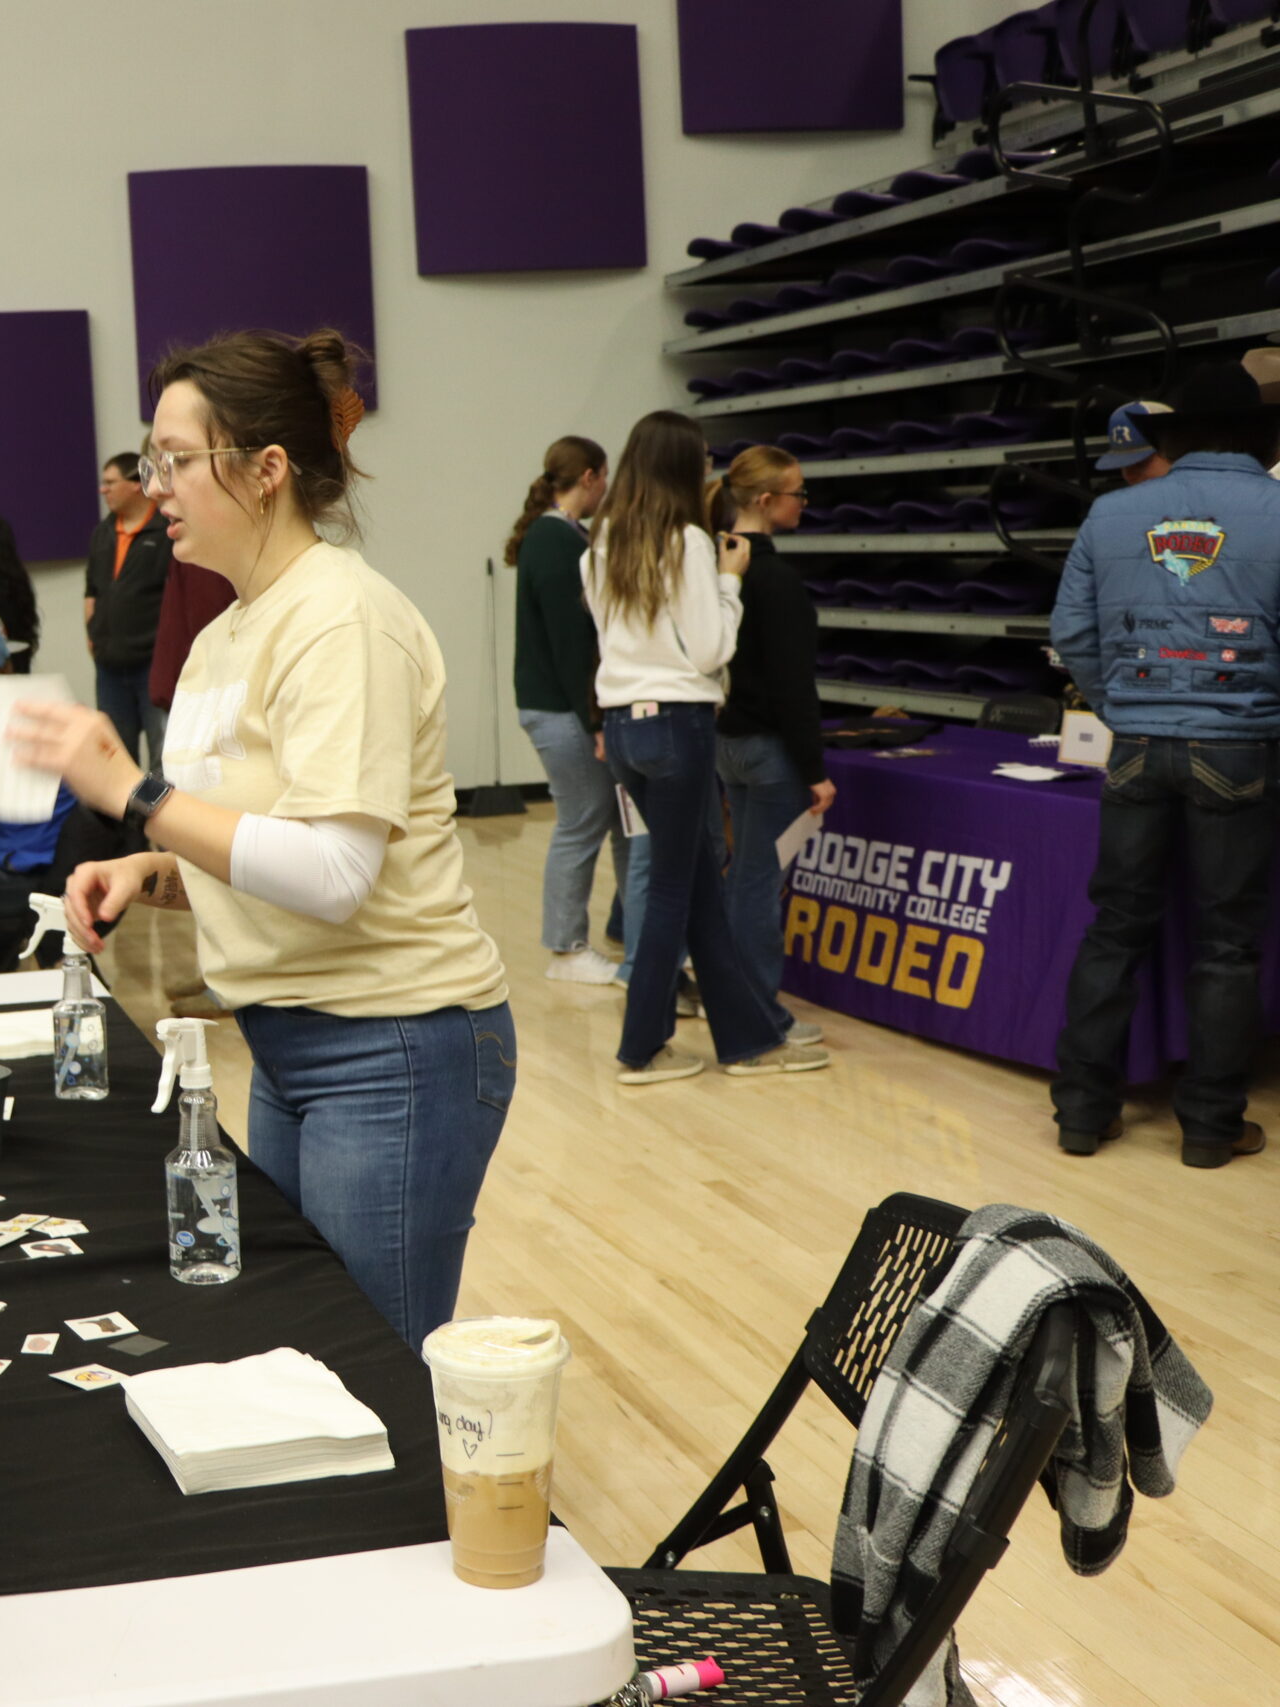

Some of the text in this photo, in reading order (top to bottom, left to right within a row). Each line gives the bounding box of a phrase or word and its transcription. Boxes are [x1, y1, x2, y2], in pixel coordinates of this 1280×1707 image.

[1154, 534, 1218, 555] RODEO
[792, 869, 991, 934] COMMUNITY COLLEGE
[797, 830, 1012, 908] DODGE CITY
[783, 894, 985, 1010] RODEO
